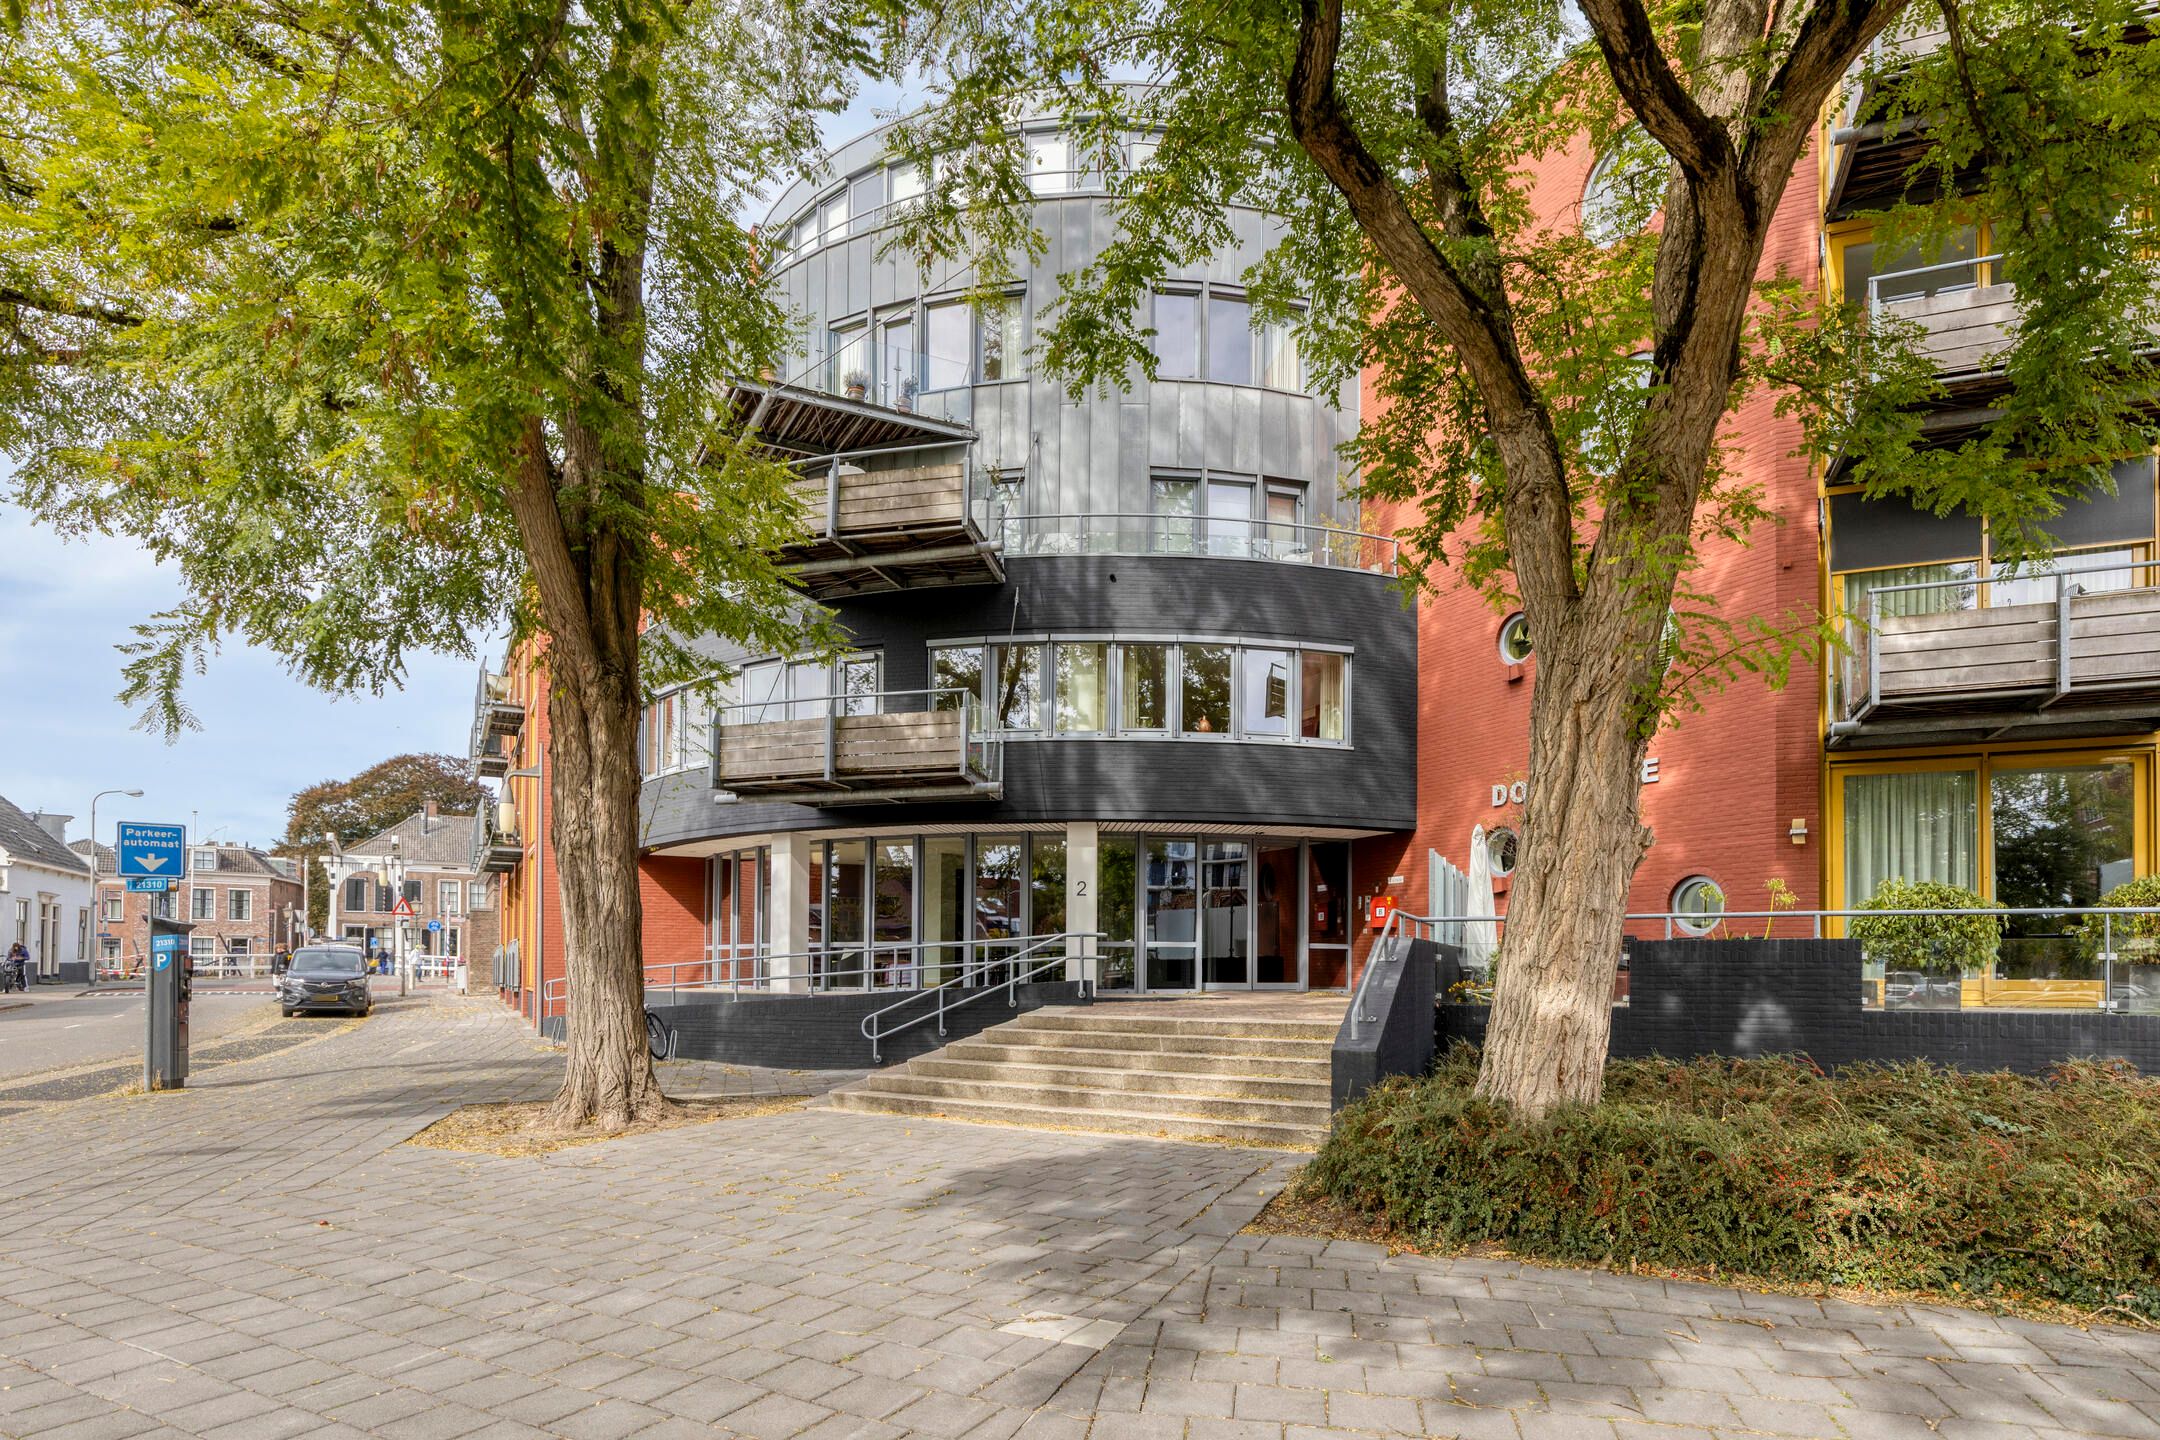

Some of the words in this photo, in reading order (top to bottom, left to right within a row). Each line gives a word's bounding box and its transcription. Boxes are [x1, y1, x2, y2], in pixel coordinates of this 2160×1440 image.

[126, 828, 177, 838] Parkeer-
[123, 839, 180, 849] automaat
[136, 880, 163, 889] 21310
[1076, 880, 1087, 897] 2
[156, 953, 167, 968] P
